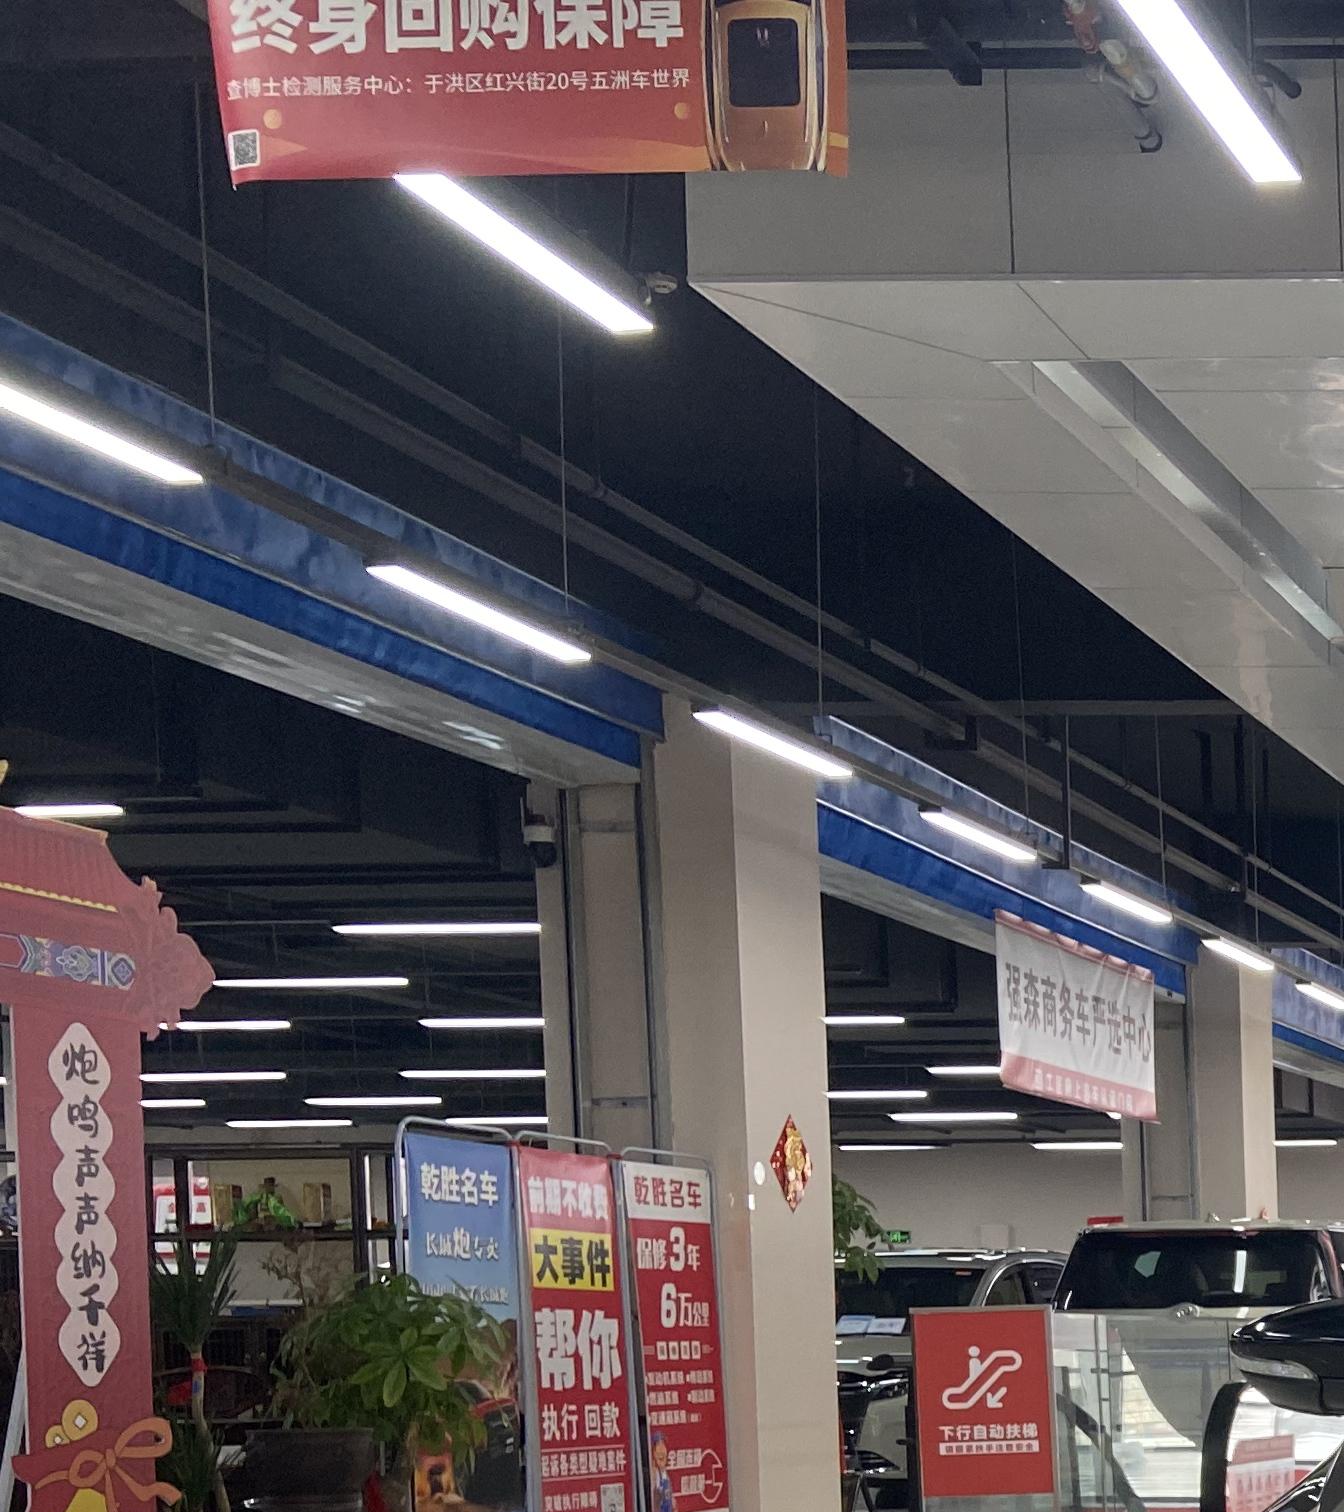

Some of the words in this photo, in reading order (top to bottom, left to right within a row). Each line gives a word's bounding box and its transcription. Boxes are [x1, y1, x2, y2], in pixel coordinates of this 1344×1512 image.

[229, 0, 685, 54] 终身回购保障
[420, 1162, 499, 1206] 乾胜名车
[634, 1176, 702, 1209] 乾胜名车
[62, 1042, 106, 1373] 炮鸣声声纳千祥
[535, 1235, 610, 1287] 大事件
[637, 1227, 700, 1272] 保修3年
[661, 1283, 709, 1328] 6万公里
[535, 1308, 623, 1392] 帮你
[542, 1403, 578, 1441] 执行
[584, 1401, 621, 1439] 回款
[938, 1422, 1038, 1441] 下行自动扶梯
